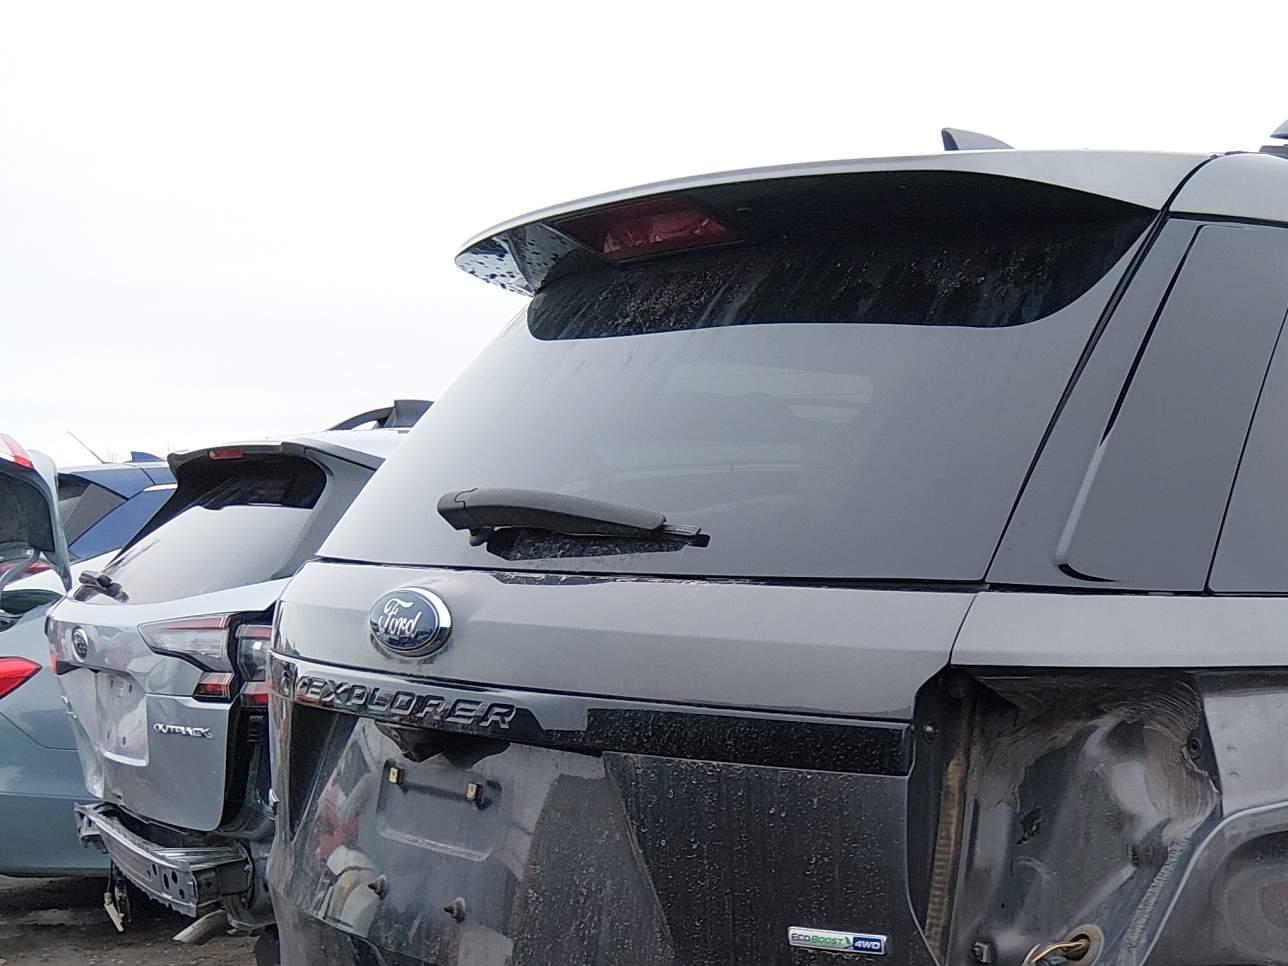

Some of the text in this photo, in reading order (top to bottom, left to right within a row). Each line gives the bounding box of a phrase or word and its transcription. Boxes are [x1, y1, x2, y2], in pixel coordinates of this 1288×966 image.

[377, 598, 422, 638] Ford
[305, 675, 517, 730] EXPLORER
[854, 940, 881, 950] 4WD
